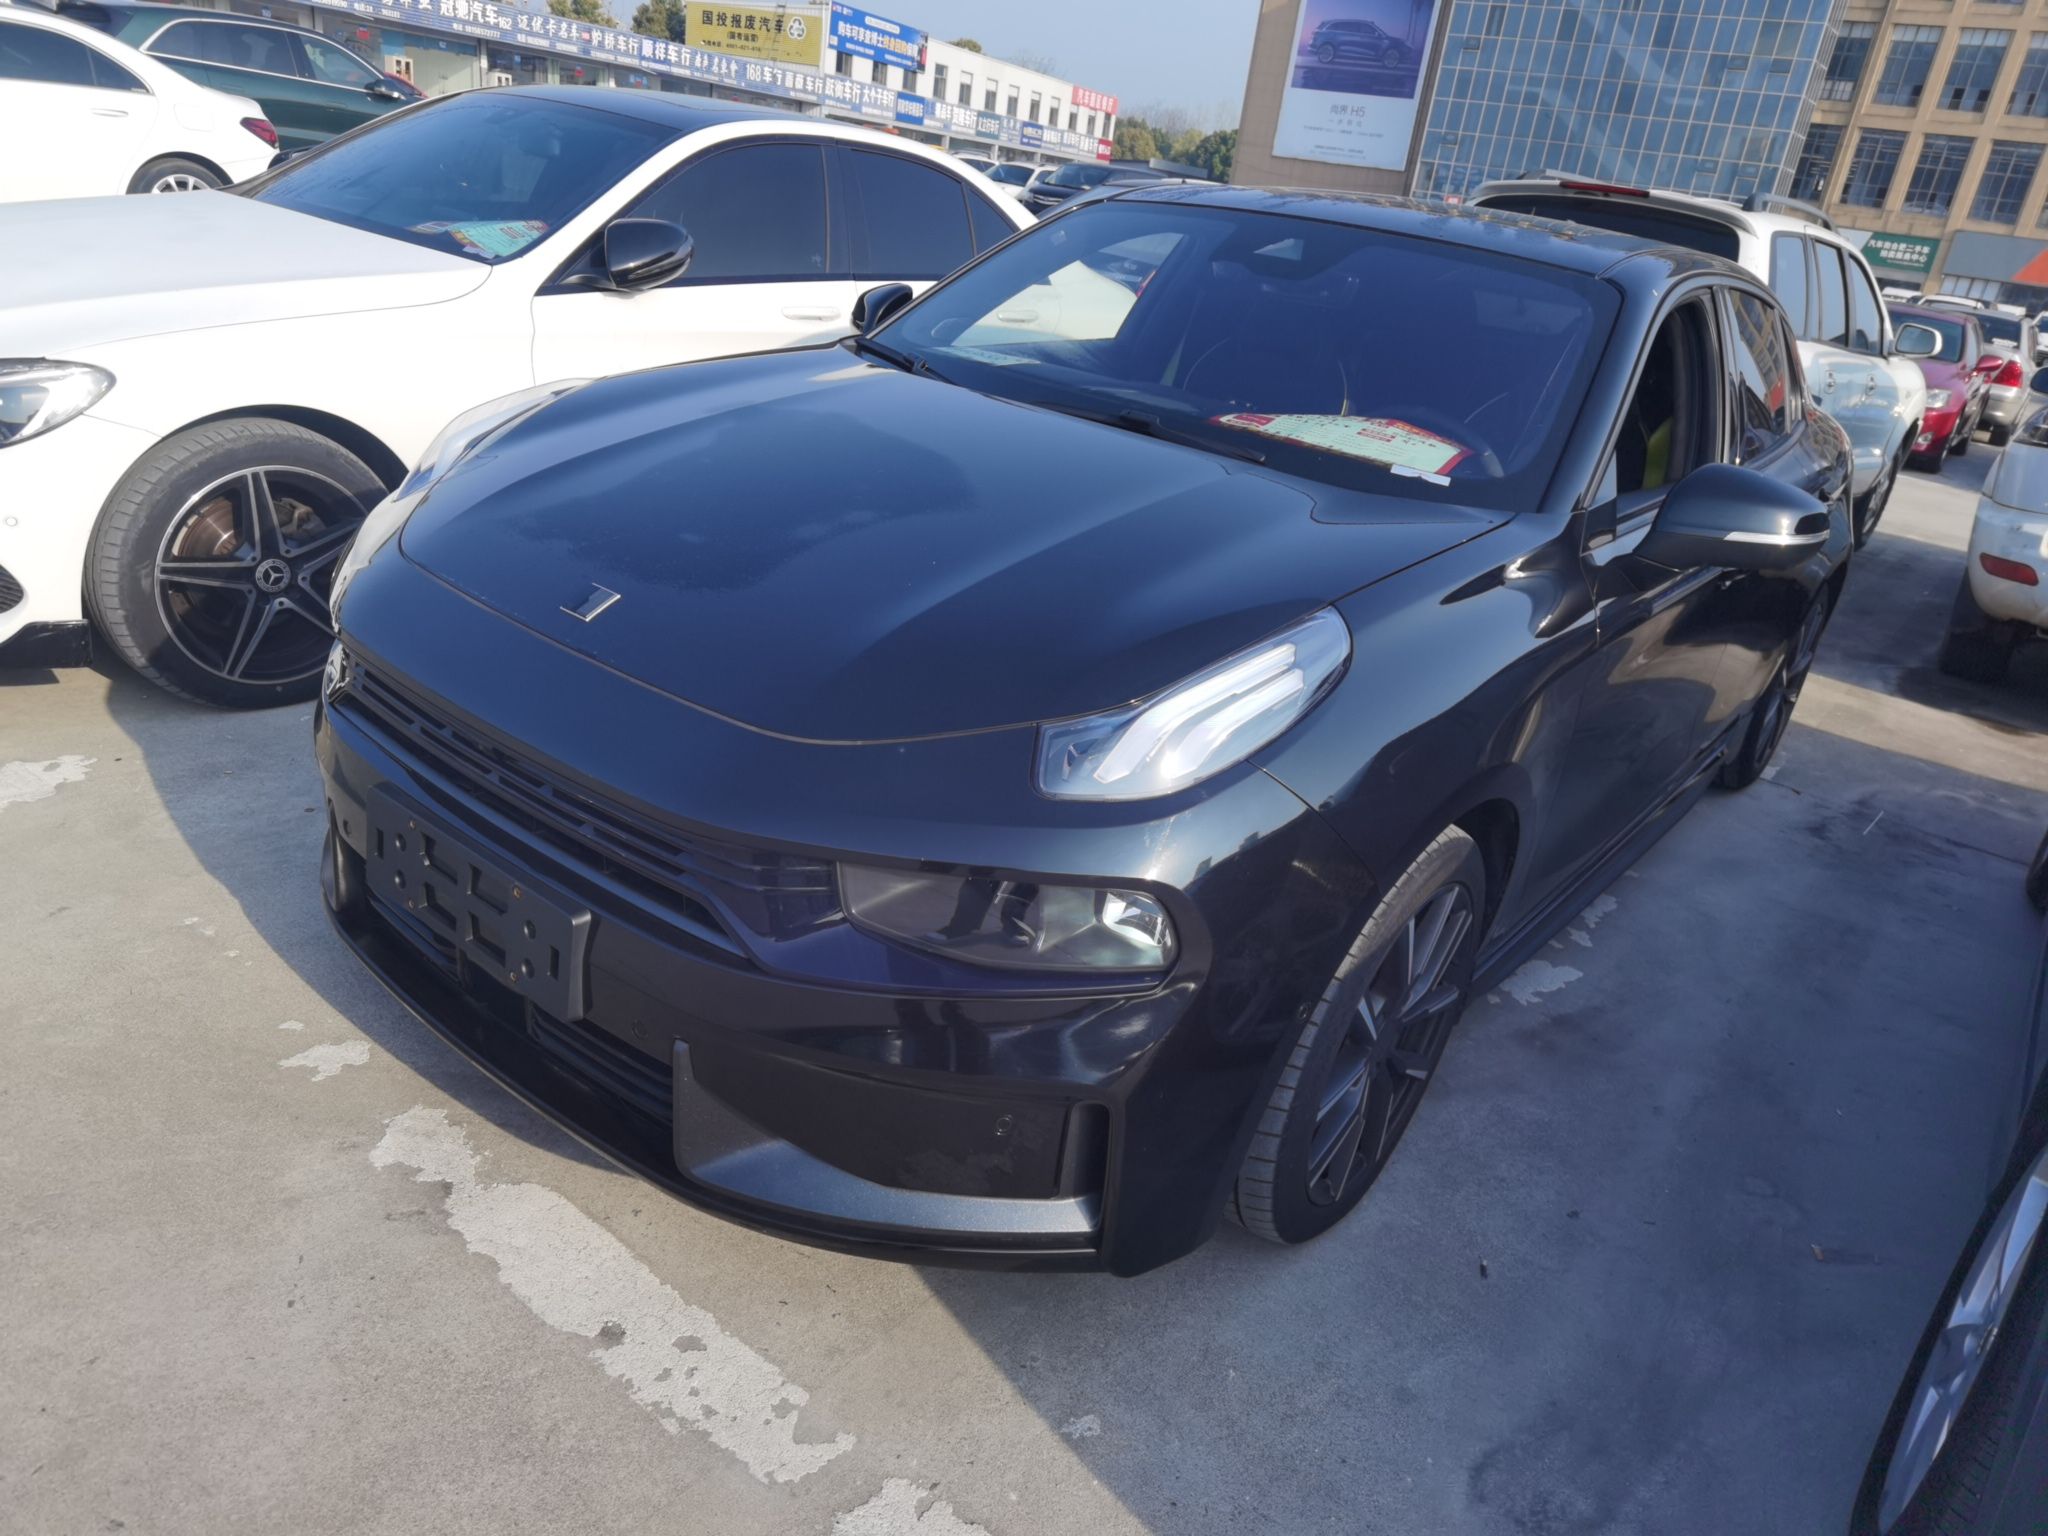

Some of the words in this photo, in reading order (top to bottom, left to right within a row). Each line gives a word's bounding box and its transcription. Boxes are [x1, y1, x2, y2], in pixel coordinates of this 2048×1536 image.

[702, 10, 785, 33] 国投报废汽车
[642, 38, 691, 67] 顺祥车行
[1350, 105, 1366, 118] H5
